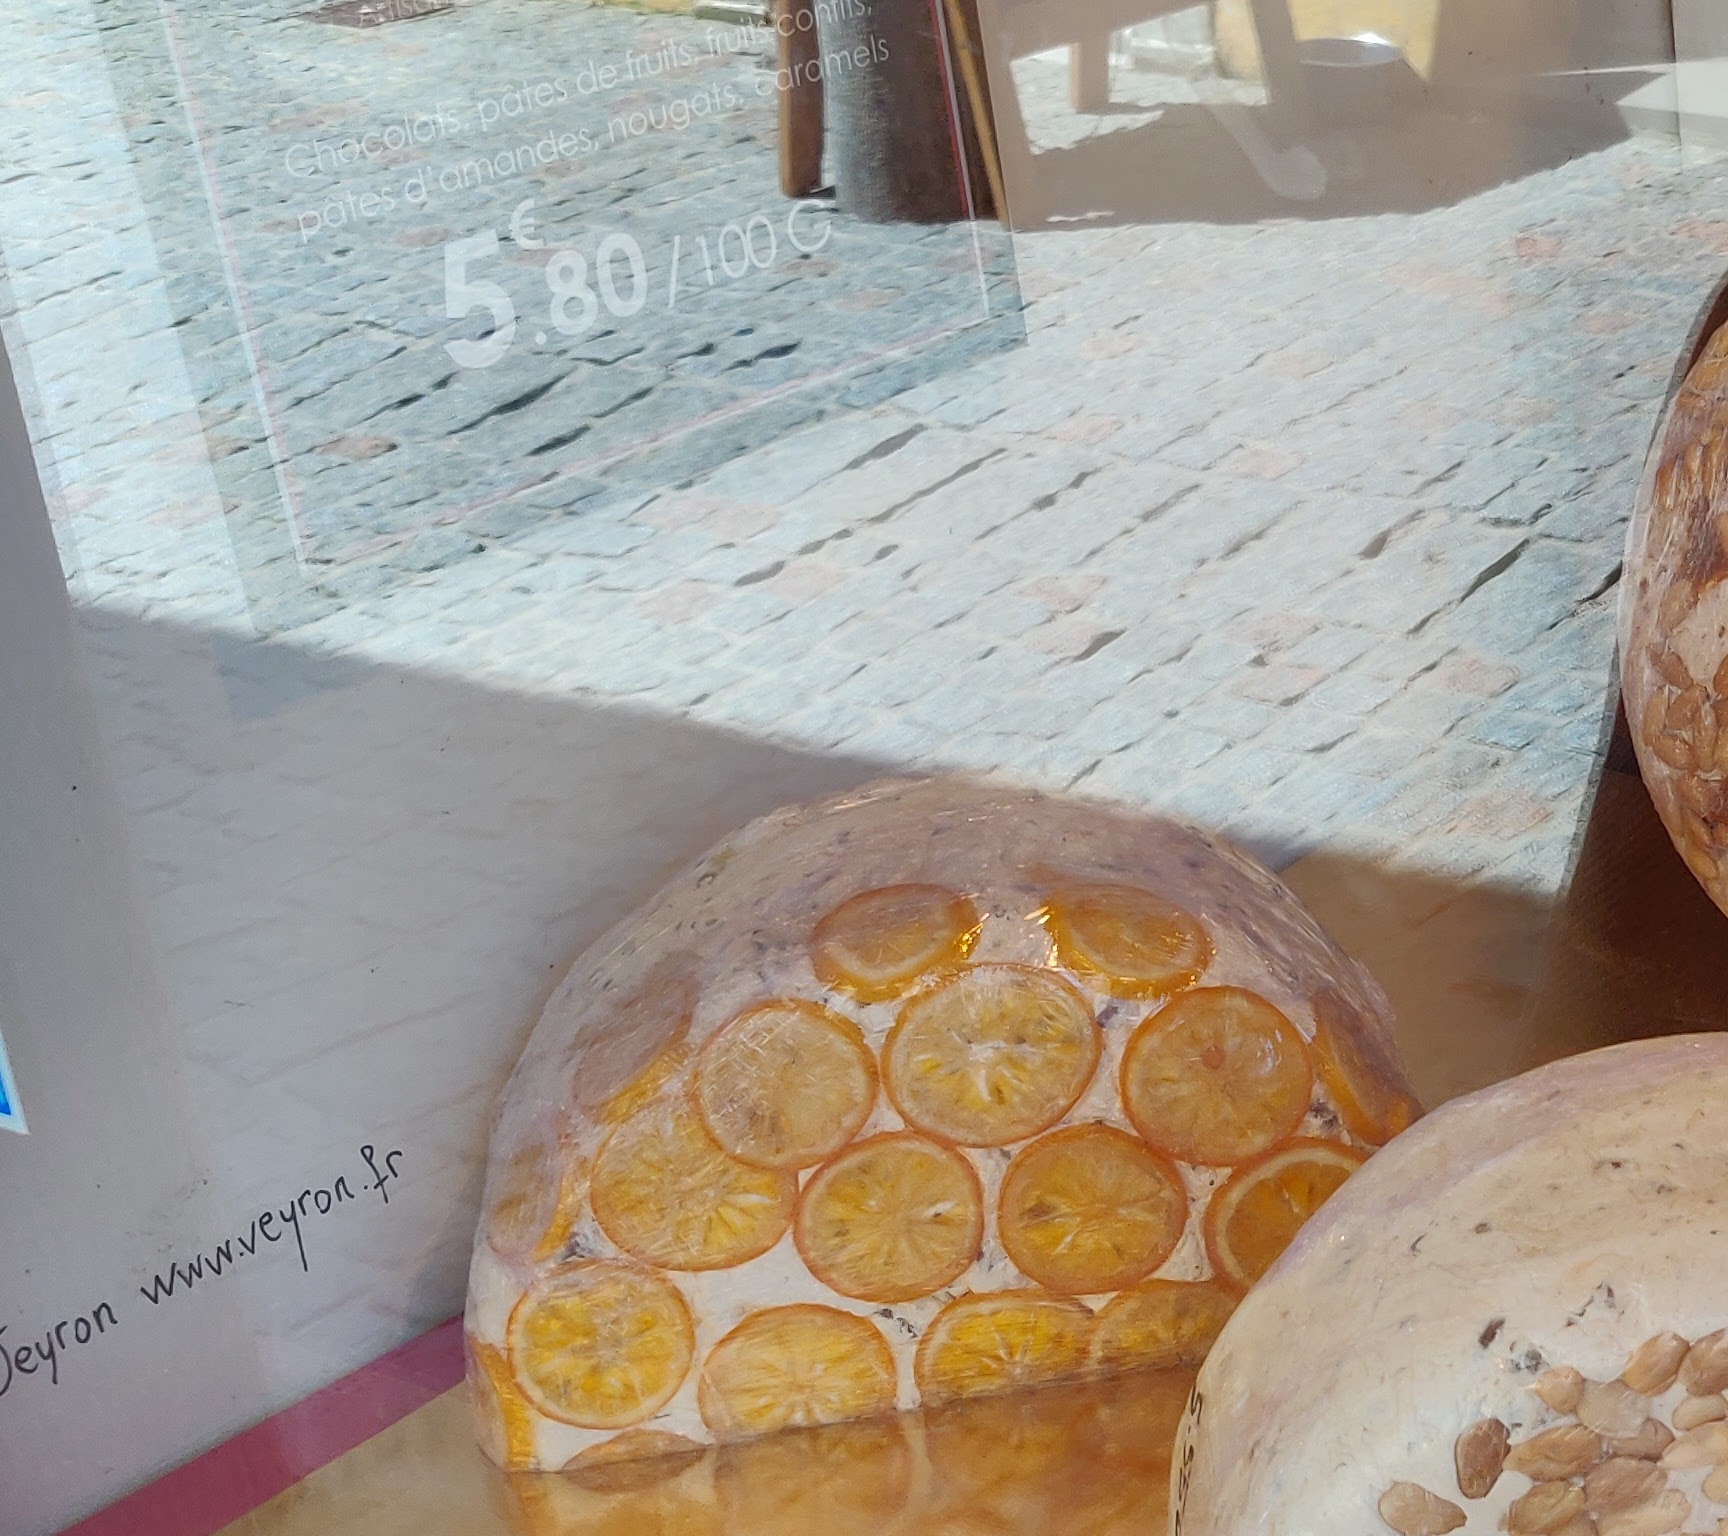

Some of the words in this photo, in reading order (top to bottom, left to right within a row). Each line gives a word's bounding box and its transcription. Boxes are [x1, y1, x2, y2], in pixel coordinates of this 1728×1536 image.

[297, 184, 397, 244] pâtes
[402, 125, 600, 206] d'amandes,
[754, 33, 890, 96] caramels
[477, 77, 568, 132] pâtes
[575, 56, 618, 97] de
[140, 1144, 403, 1305] www.veyron.fr
